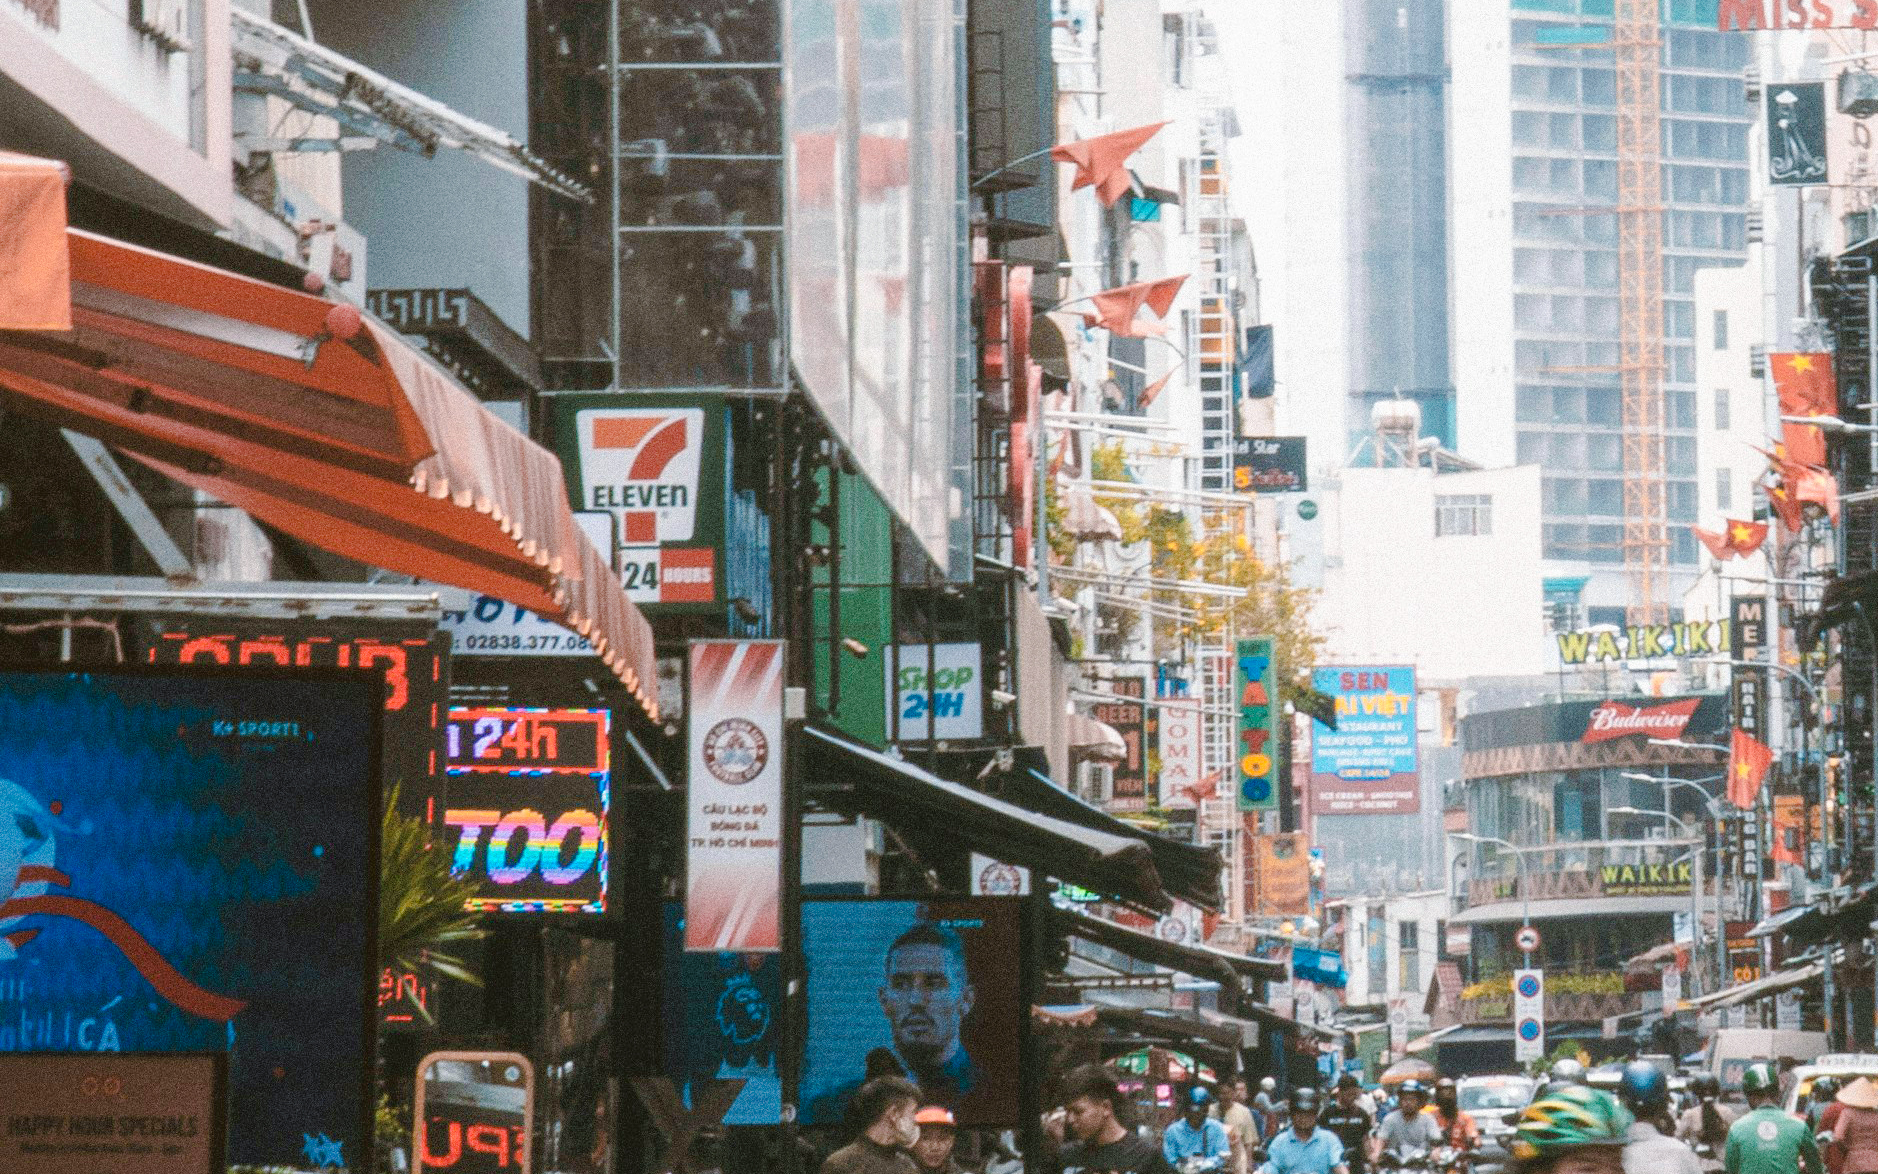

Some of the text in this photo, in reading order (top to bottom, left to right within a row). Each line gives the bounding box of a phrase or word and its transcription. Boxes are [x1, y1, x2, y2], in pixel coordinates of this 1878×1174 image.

[592, 416, 688, 480] 7
[593, 485, 688, 507] ELEVEN
[623, 561, 712, 590] 24 HOURS
[1557, 617, 1730, 664] WAIKIKI
[898, 666, 973, 690] SHOP
[1340, 672, 1388, 690] SEN
[903, 693, 965, 718] 24H
[1239, 655, 1271, 801] TATTOO
[1589, 706, 1693, 734] Budweiser
[473, 716, 556, 759] 24h
[1601, 863, 1691, 883] WAIKIK
